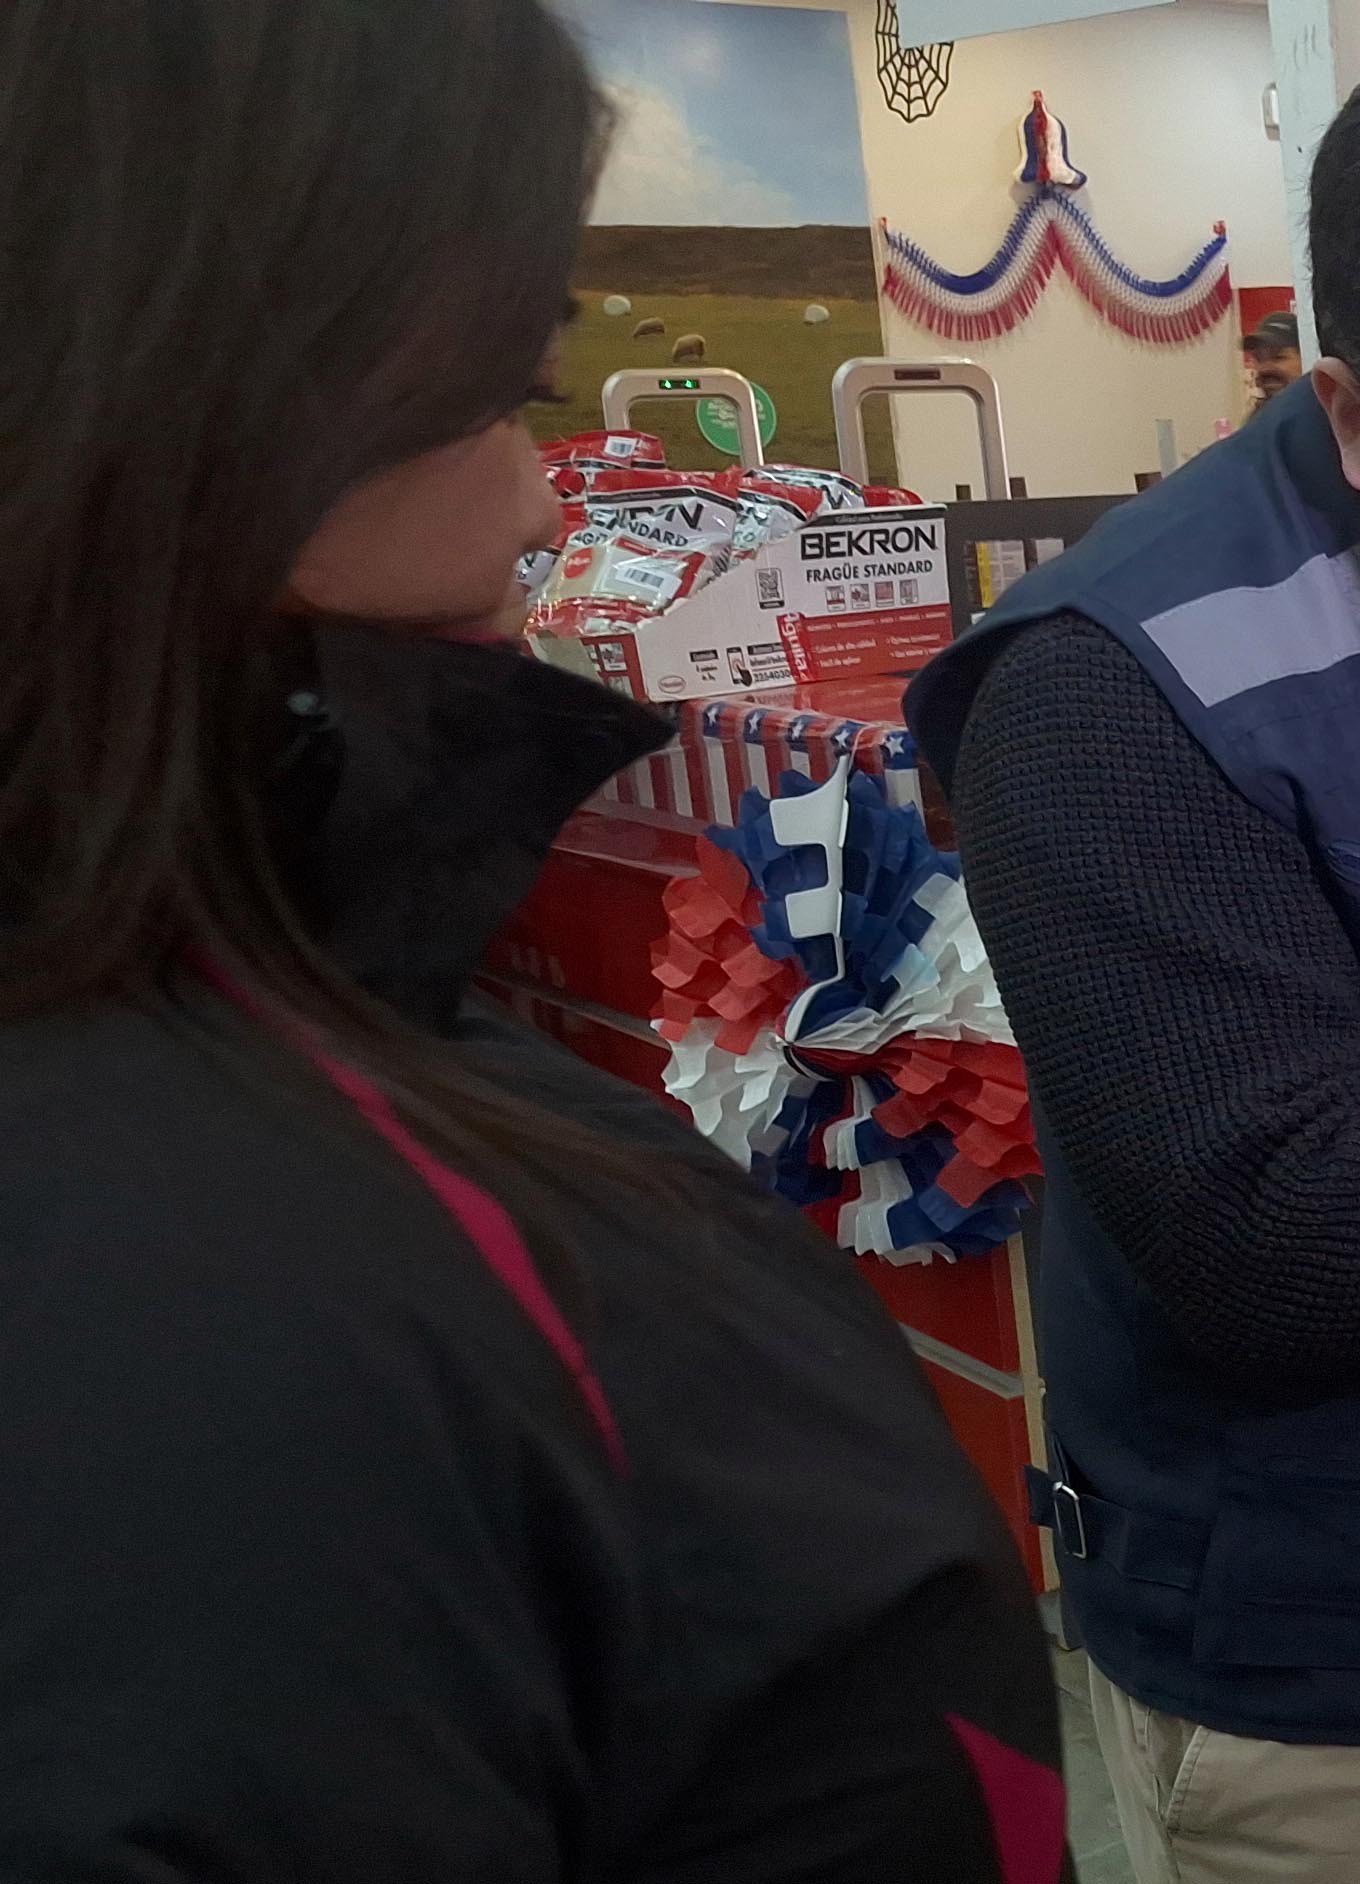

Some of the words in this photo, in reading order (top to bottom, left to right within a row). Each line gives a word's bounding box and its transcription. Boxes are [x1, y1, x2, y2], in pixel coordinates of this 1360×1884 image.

[629, 521, 689, 547] NDARD
[801, 525, 937, 560] BEKRON
[806, 563, 859, 583] FRAGÜE
[864, 560, 933, 578] STANDARD
